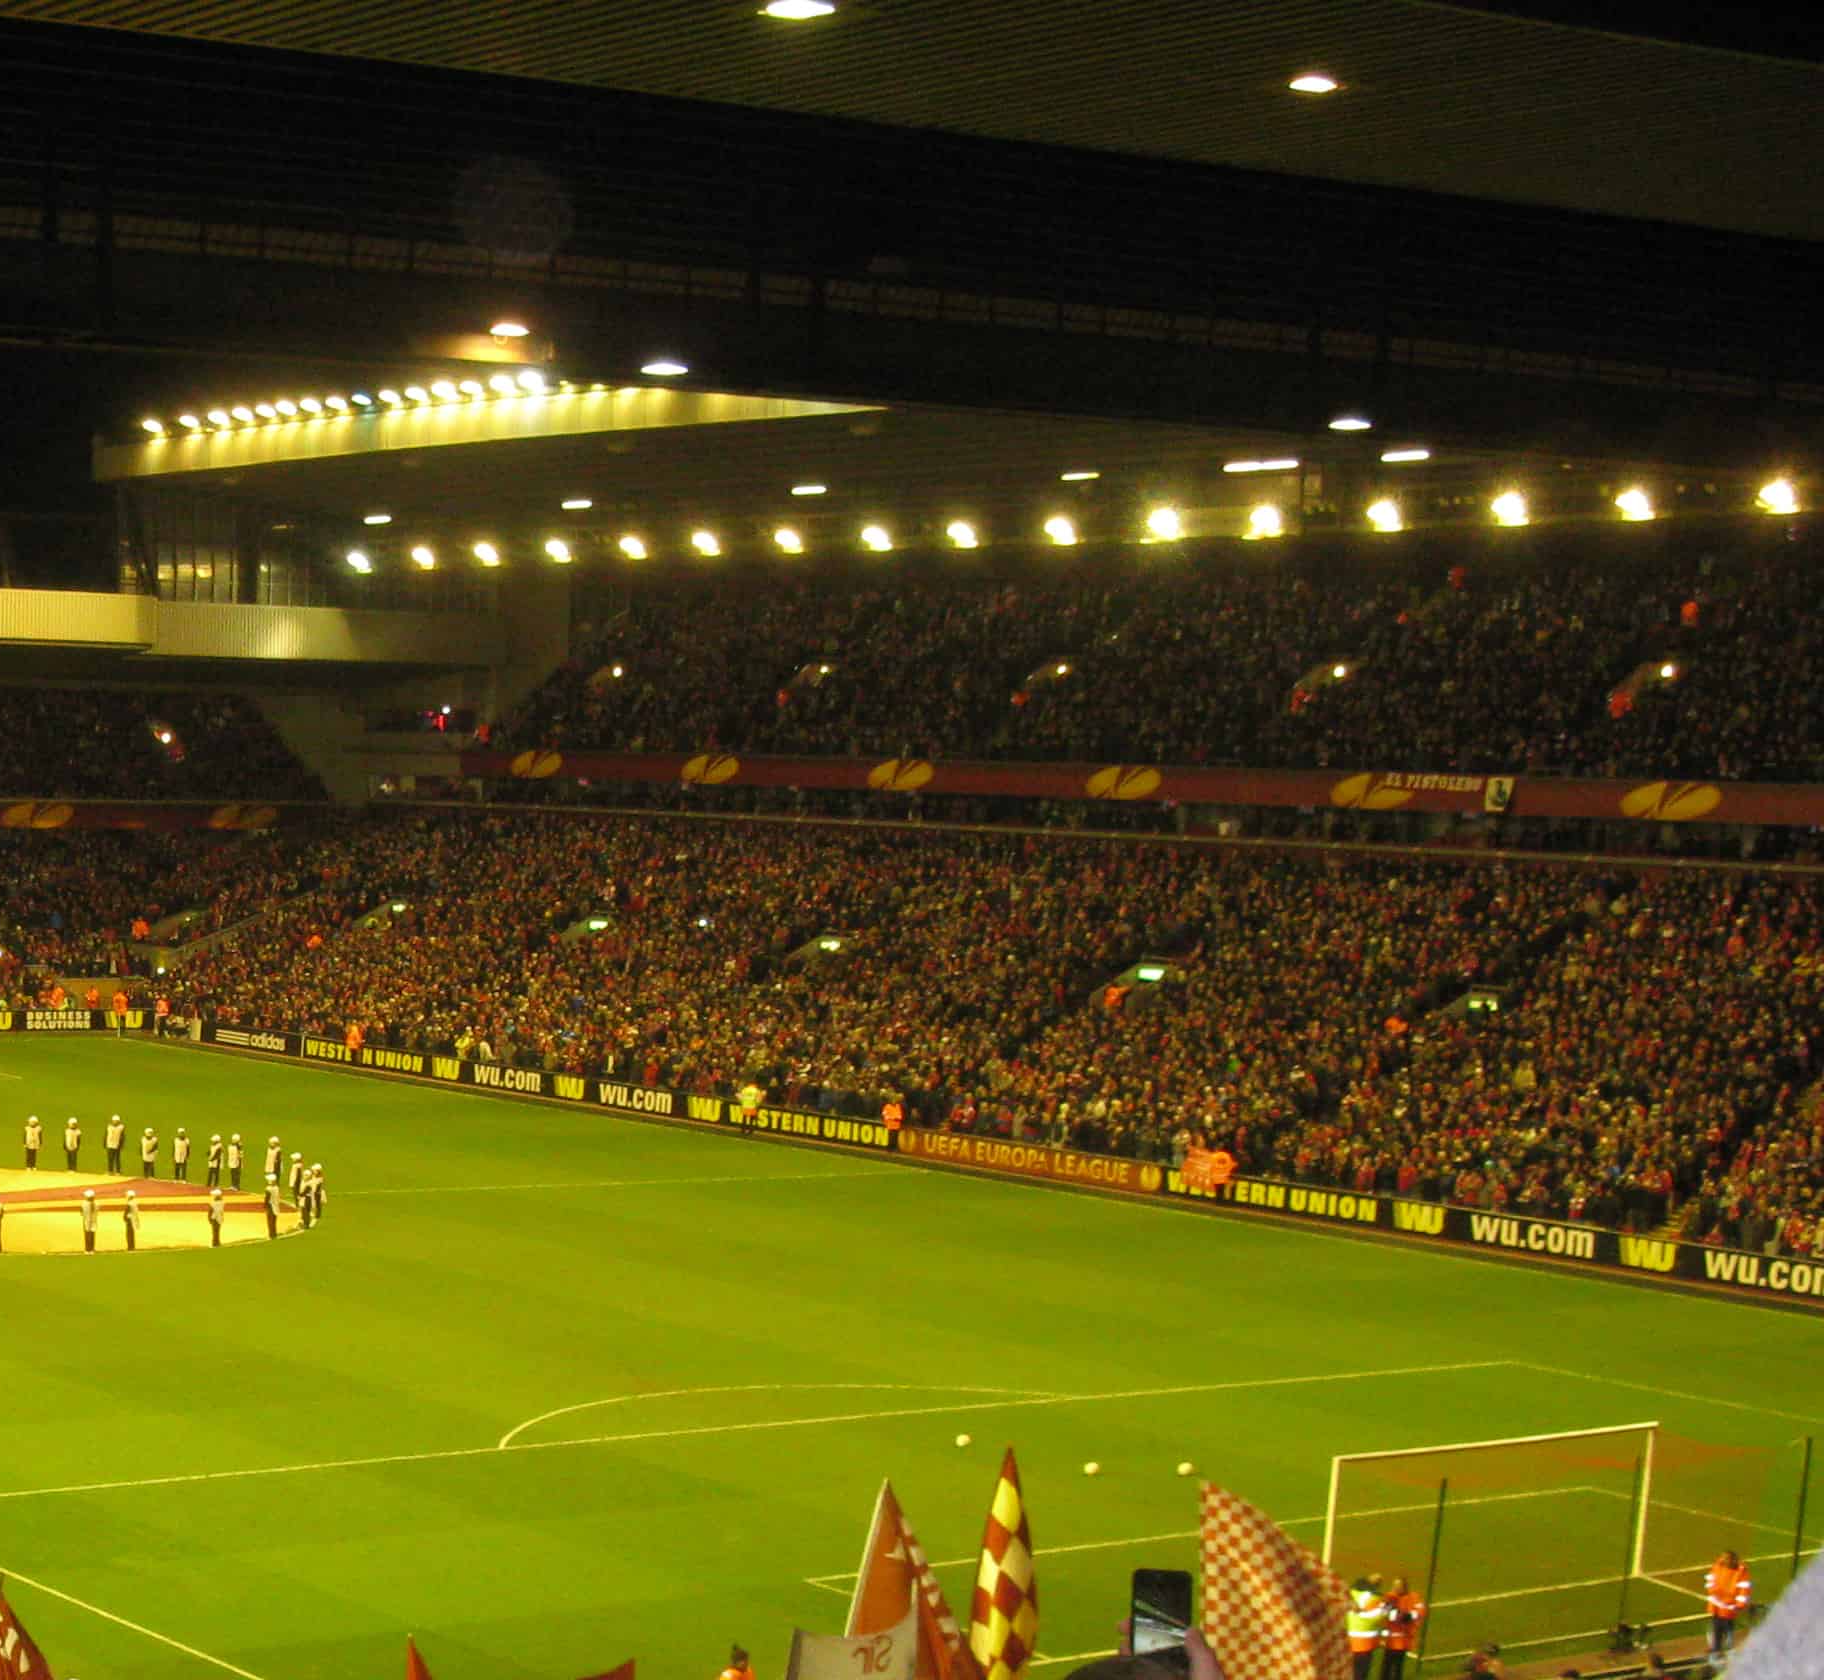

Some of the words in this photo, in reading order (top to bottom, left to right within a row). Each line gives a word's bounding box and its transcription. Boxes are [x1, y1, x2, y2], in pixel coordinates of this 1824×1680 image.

[26, 1011, 91, 1020] BUSINESS
[26, 1020, 91, 1029] SOLUTIONS
[250, 1032, 286, 1051] adidas
[306, 1039, 372, 1066] WESTEN
[375, 1050, 424, 1073] UNION
[432, 1056, 461, 1081] WU
[553, 1074, 585, 1100] WU
[688, 1096, 722, 1122] WU
[824, 1118, 889, 1146] UNION
[924, 1133, 970, 1159] UEFA
[976, 1141, 1048, 1170] EUROPA
[1054, 1152, 1132, 1184] LEAGUE
[1289, 1188, 1377, 1222] UNION
[1392, 1200, 1446, 1234] WU
[1618, 1236, 1677, 1273] WU
